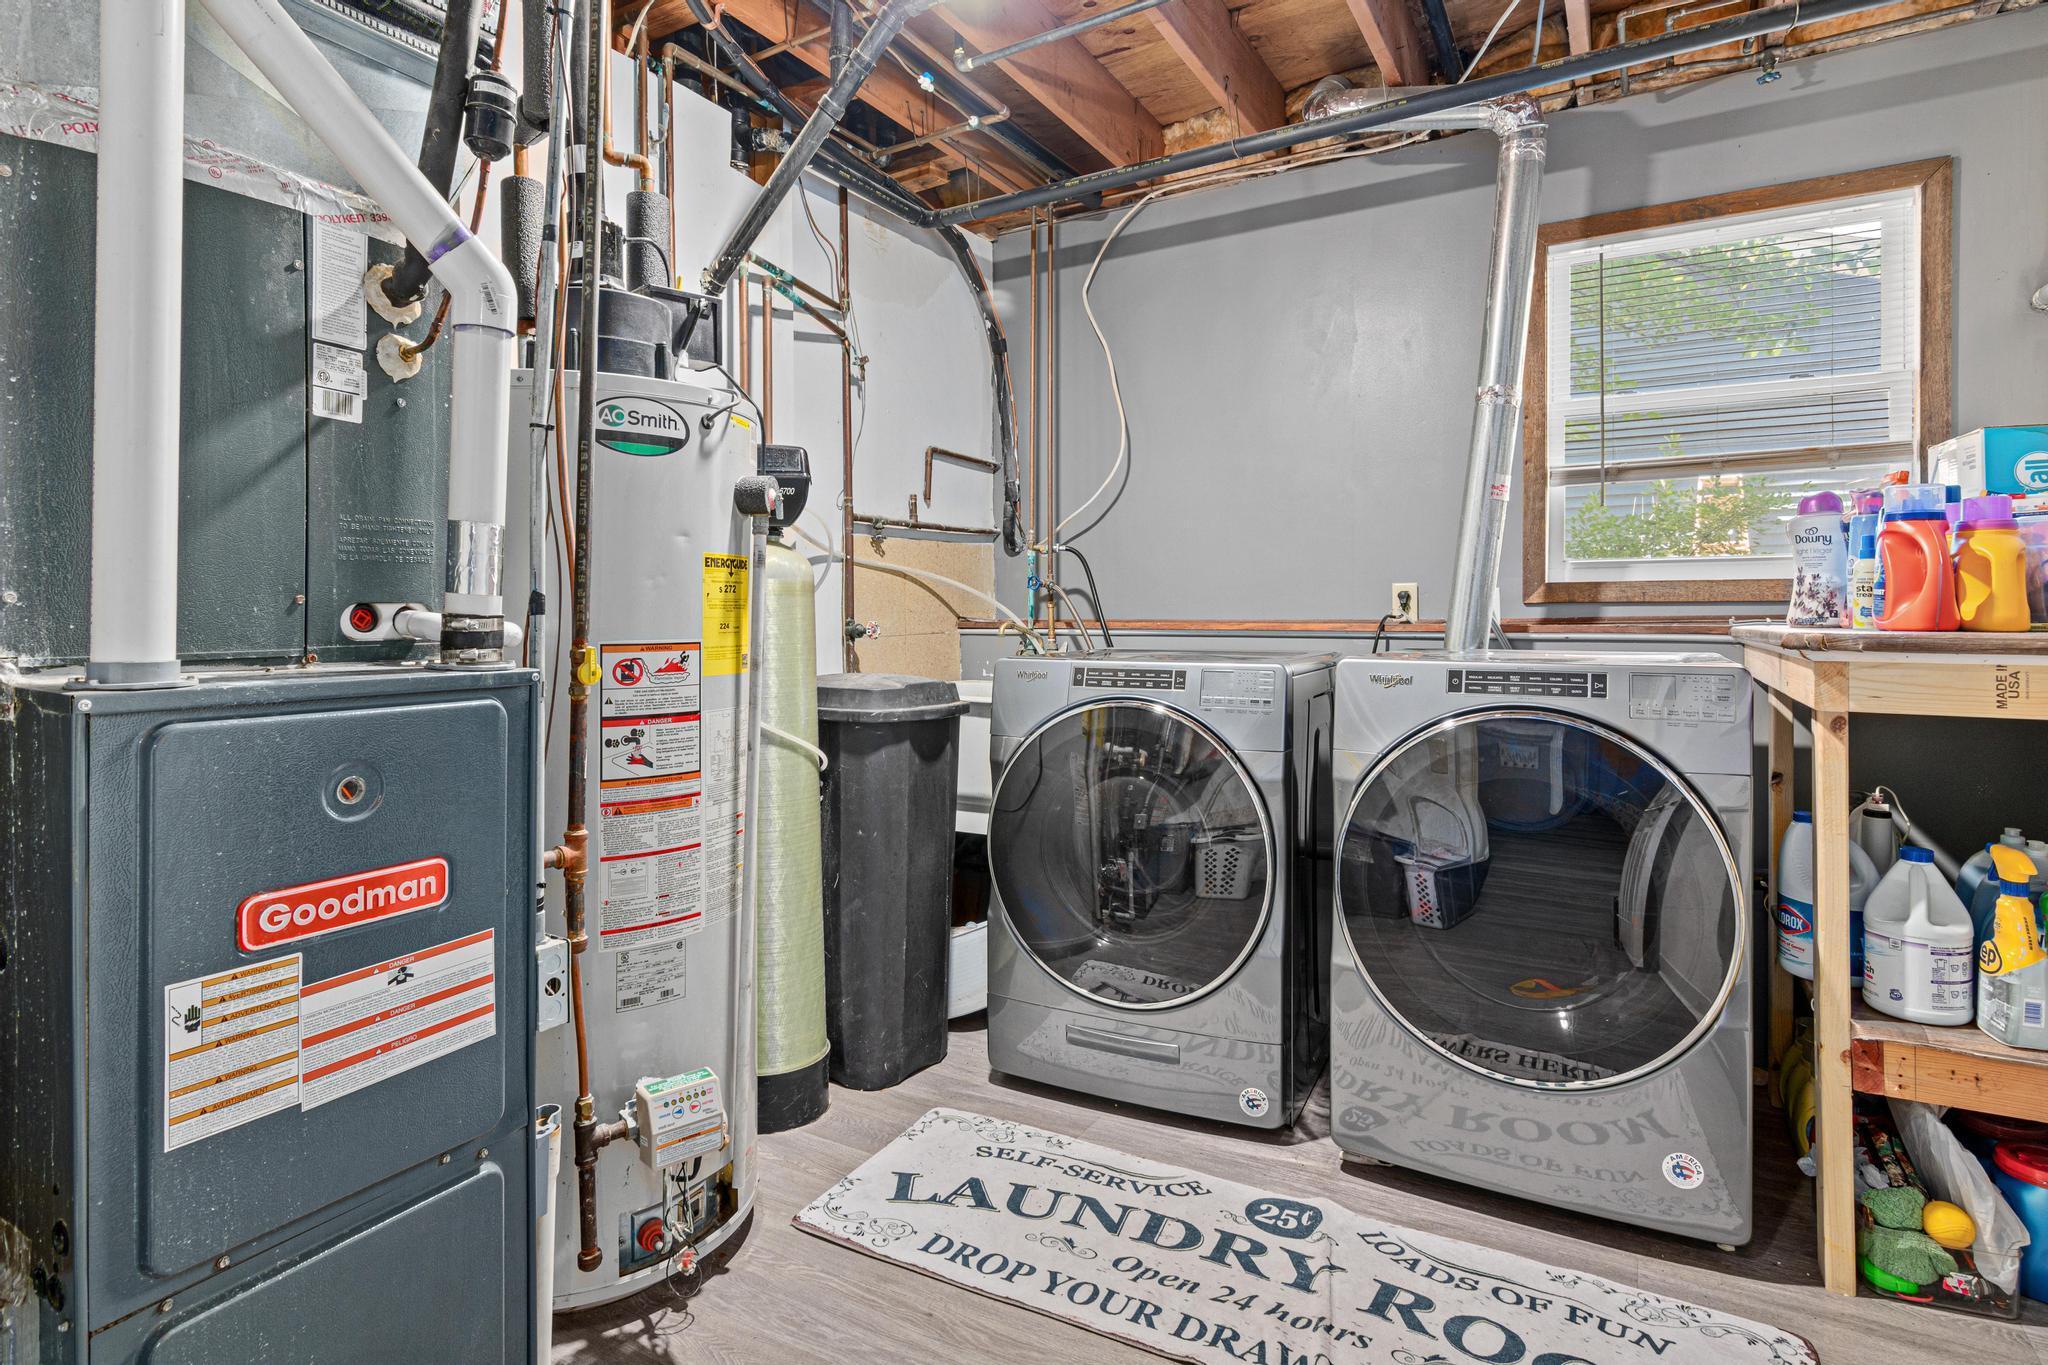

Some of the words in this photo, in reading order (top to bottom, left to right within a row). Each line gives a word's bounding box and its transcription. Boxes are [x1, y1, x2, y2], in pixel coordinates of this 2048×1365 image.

[586, 147, 595, 189] STEEL
[599, 407, 625, 424] AO
[627, 409, 678, 431] Smith
[1794, 534, 1833, 546] Downy
[704, 556, 748, 571] ENERGYGUIDE
[1016, 669, 1048, 682] Whirlpool
[1369, 674, 1414, 688] Whirlpool
[2008, 671, 2020, 699] USA
[1996, 675, 2008, 709] MADE
[259, 875, 437, 933] Goodman
[1777, 910, 1803, 931] LOROX
[388, 956, 416, 969] DANGER
[1980, 943, 1997, 967] ep
[240, 965, 273, 978] WARNING
[230, 1000, 282, 1020] ADVERTENCIA
[390, 1003, 416, 1017] DANGER
[225, 1029, 258, 1045] WARNING
[390, 1034, 418, 1049] PELIGRO
[224, 1064, 258, 1081] WARNING
[976, 1145, 1213, 1198] SELF-SERVICE
[1670, 1154, 1703, 1176] AMERICA
[886, 1171, 1348, 1294] LAUNDRY
[1356, 1278, 1598, 1365] RO
[917, 1232, 1037, 1284] DROP
[1040, 1271, 1163, 1331] YOUR
[1112, 1255, 1201, 1295] Open
[1210, 1285, 1259, 1312] 24
[1263, 1301, 1373, 1350] hours
[1356, 1230, 1480, 1292] LOADS
[1491, 1286, 1554, 1314] OF
[1564, 1304, 1677, 1355] FUN
